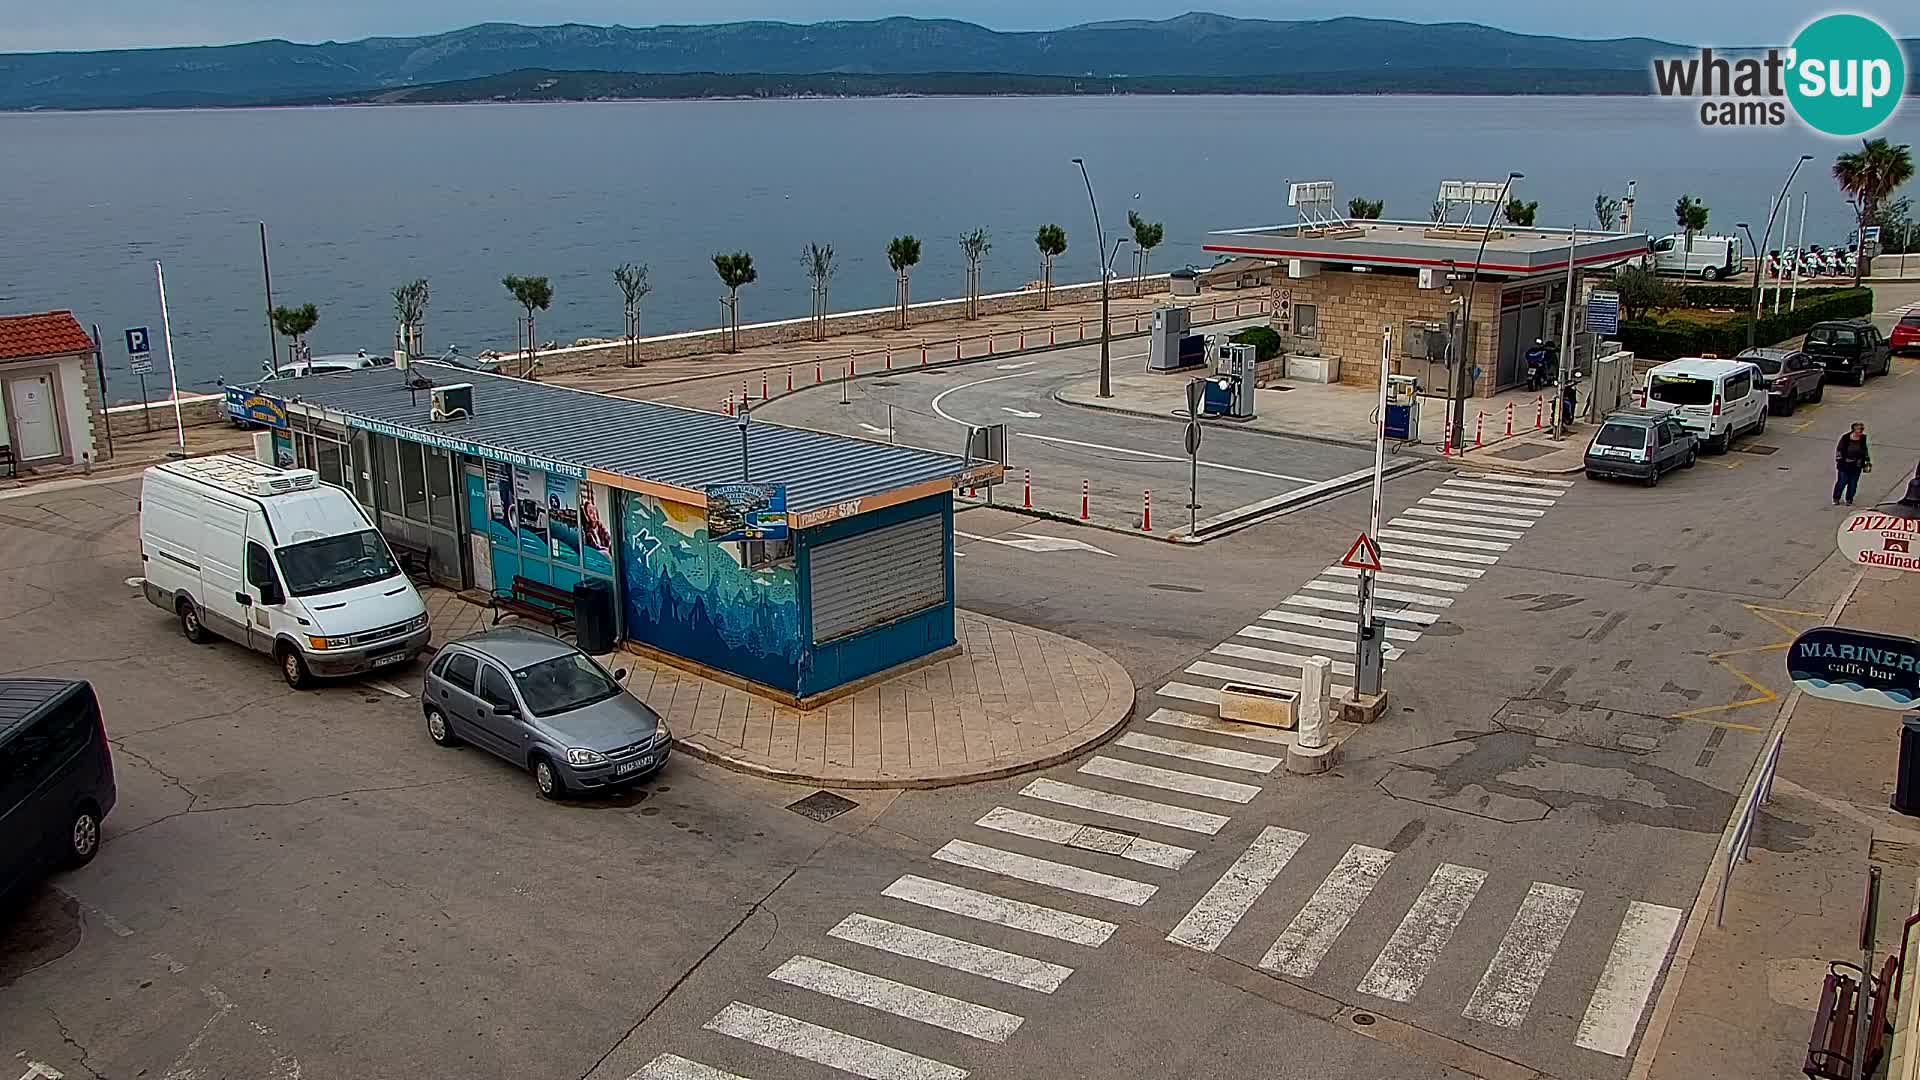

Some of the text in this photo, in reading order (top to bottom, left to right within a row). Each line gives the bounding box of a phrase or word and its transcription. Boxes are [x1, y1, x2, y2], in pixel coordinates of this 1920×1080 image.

[131, 331, 143, 350] P
[397, 428, 437, 445] AUTOBUSNA
[437, 438, 469, 452] POSTAJA
[478, 447, 494, 458] BUS
[494, 450, 527, 465] STATION
[528, 457, 554, 471] TICKET
[555, 463, 583, 477] OFFICE
[1881, 531, 1917, 541] GRILL
[1828, 663, 1896, 680] caffe bar
